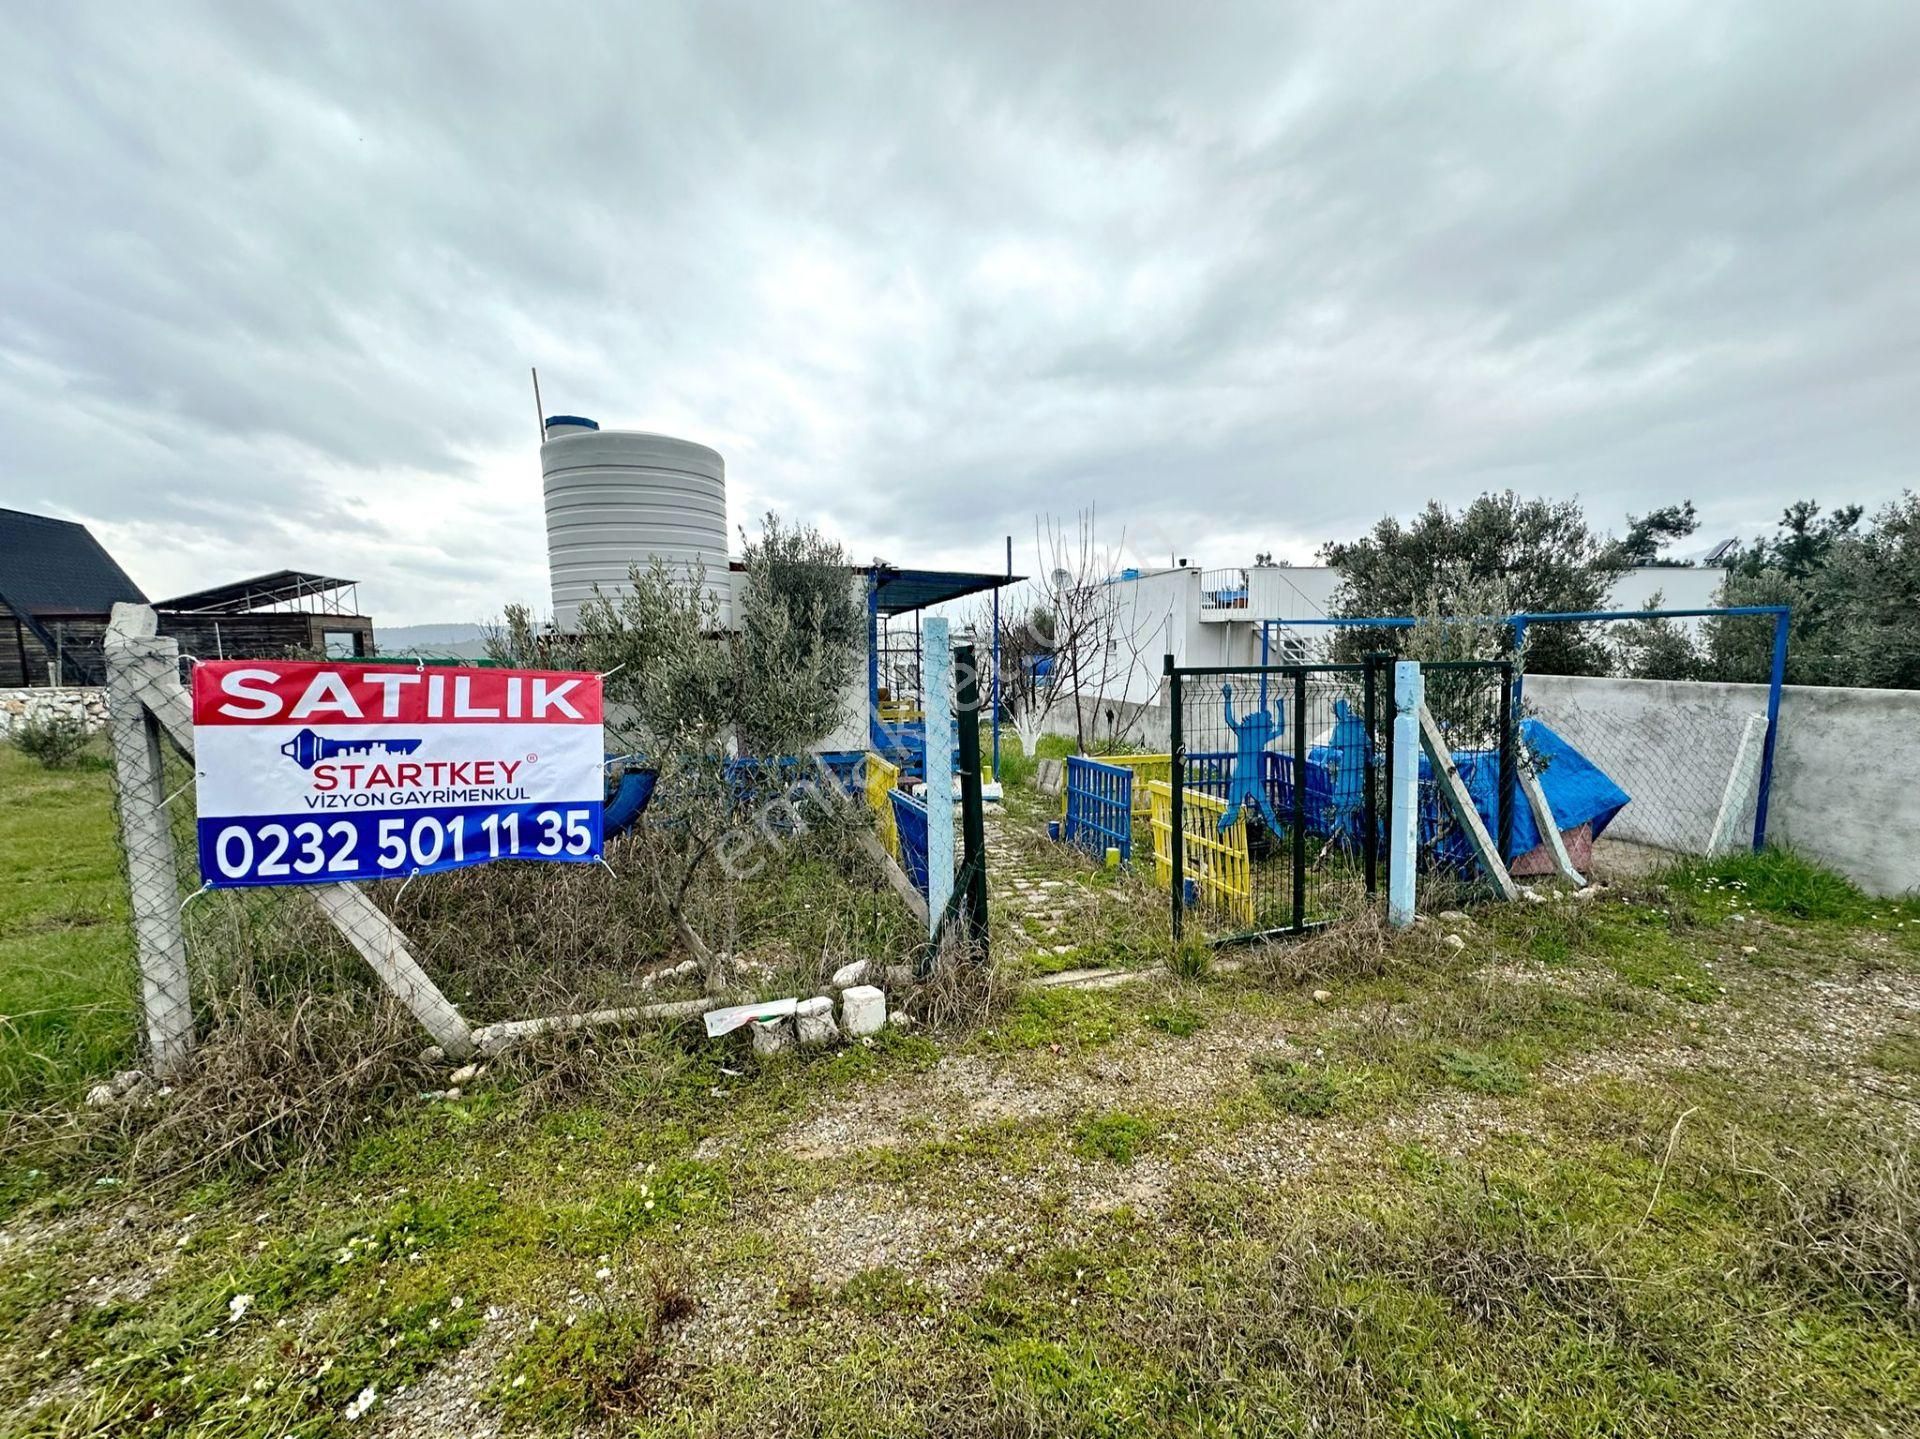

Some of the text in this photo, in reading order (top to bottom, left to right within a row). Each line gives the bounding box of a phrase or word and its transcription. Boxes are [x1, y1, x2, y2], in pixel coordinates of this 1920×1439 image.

[217, 668, 585, 720] SATILIK
[313, 760, 522, 791] STARTKEY
[304, 787, 530, 808] VİZYON GAYRİMENKUL
[216, 809, 592, 879] 0232 501 11 35
